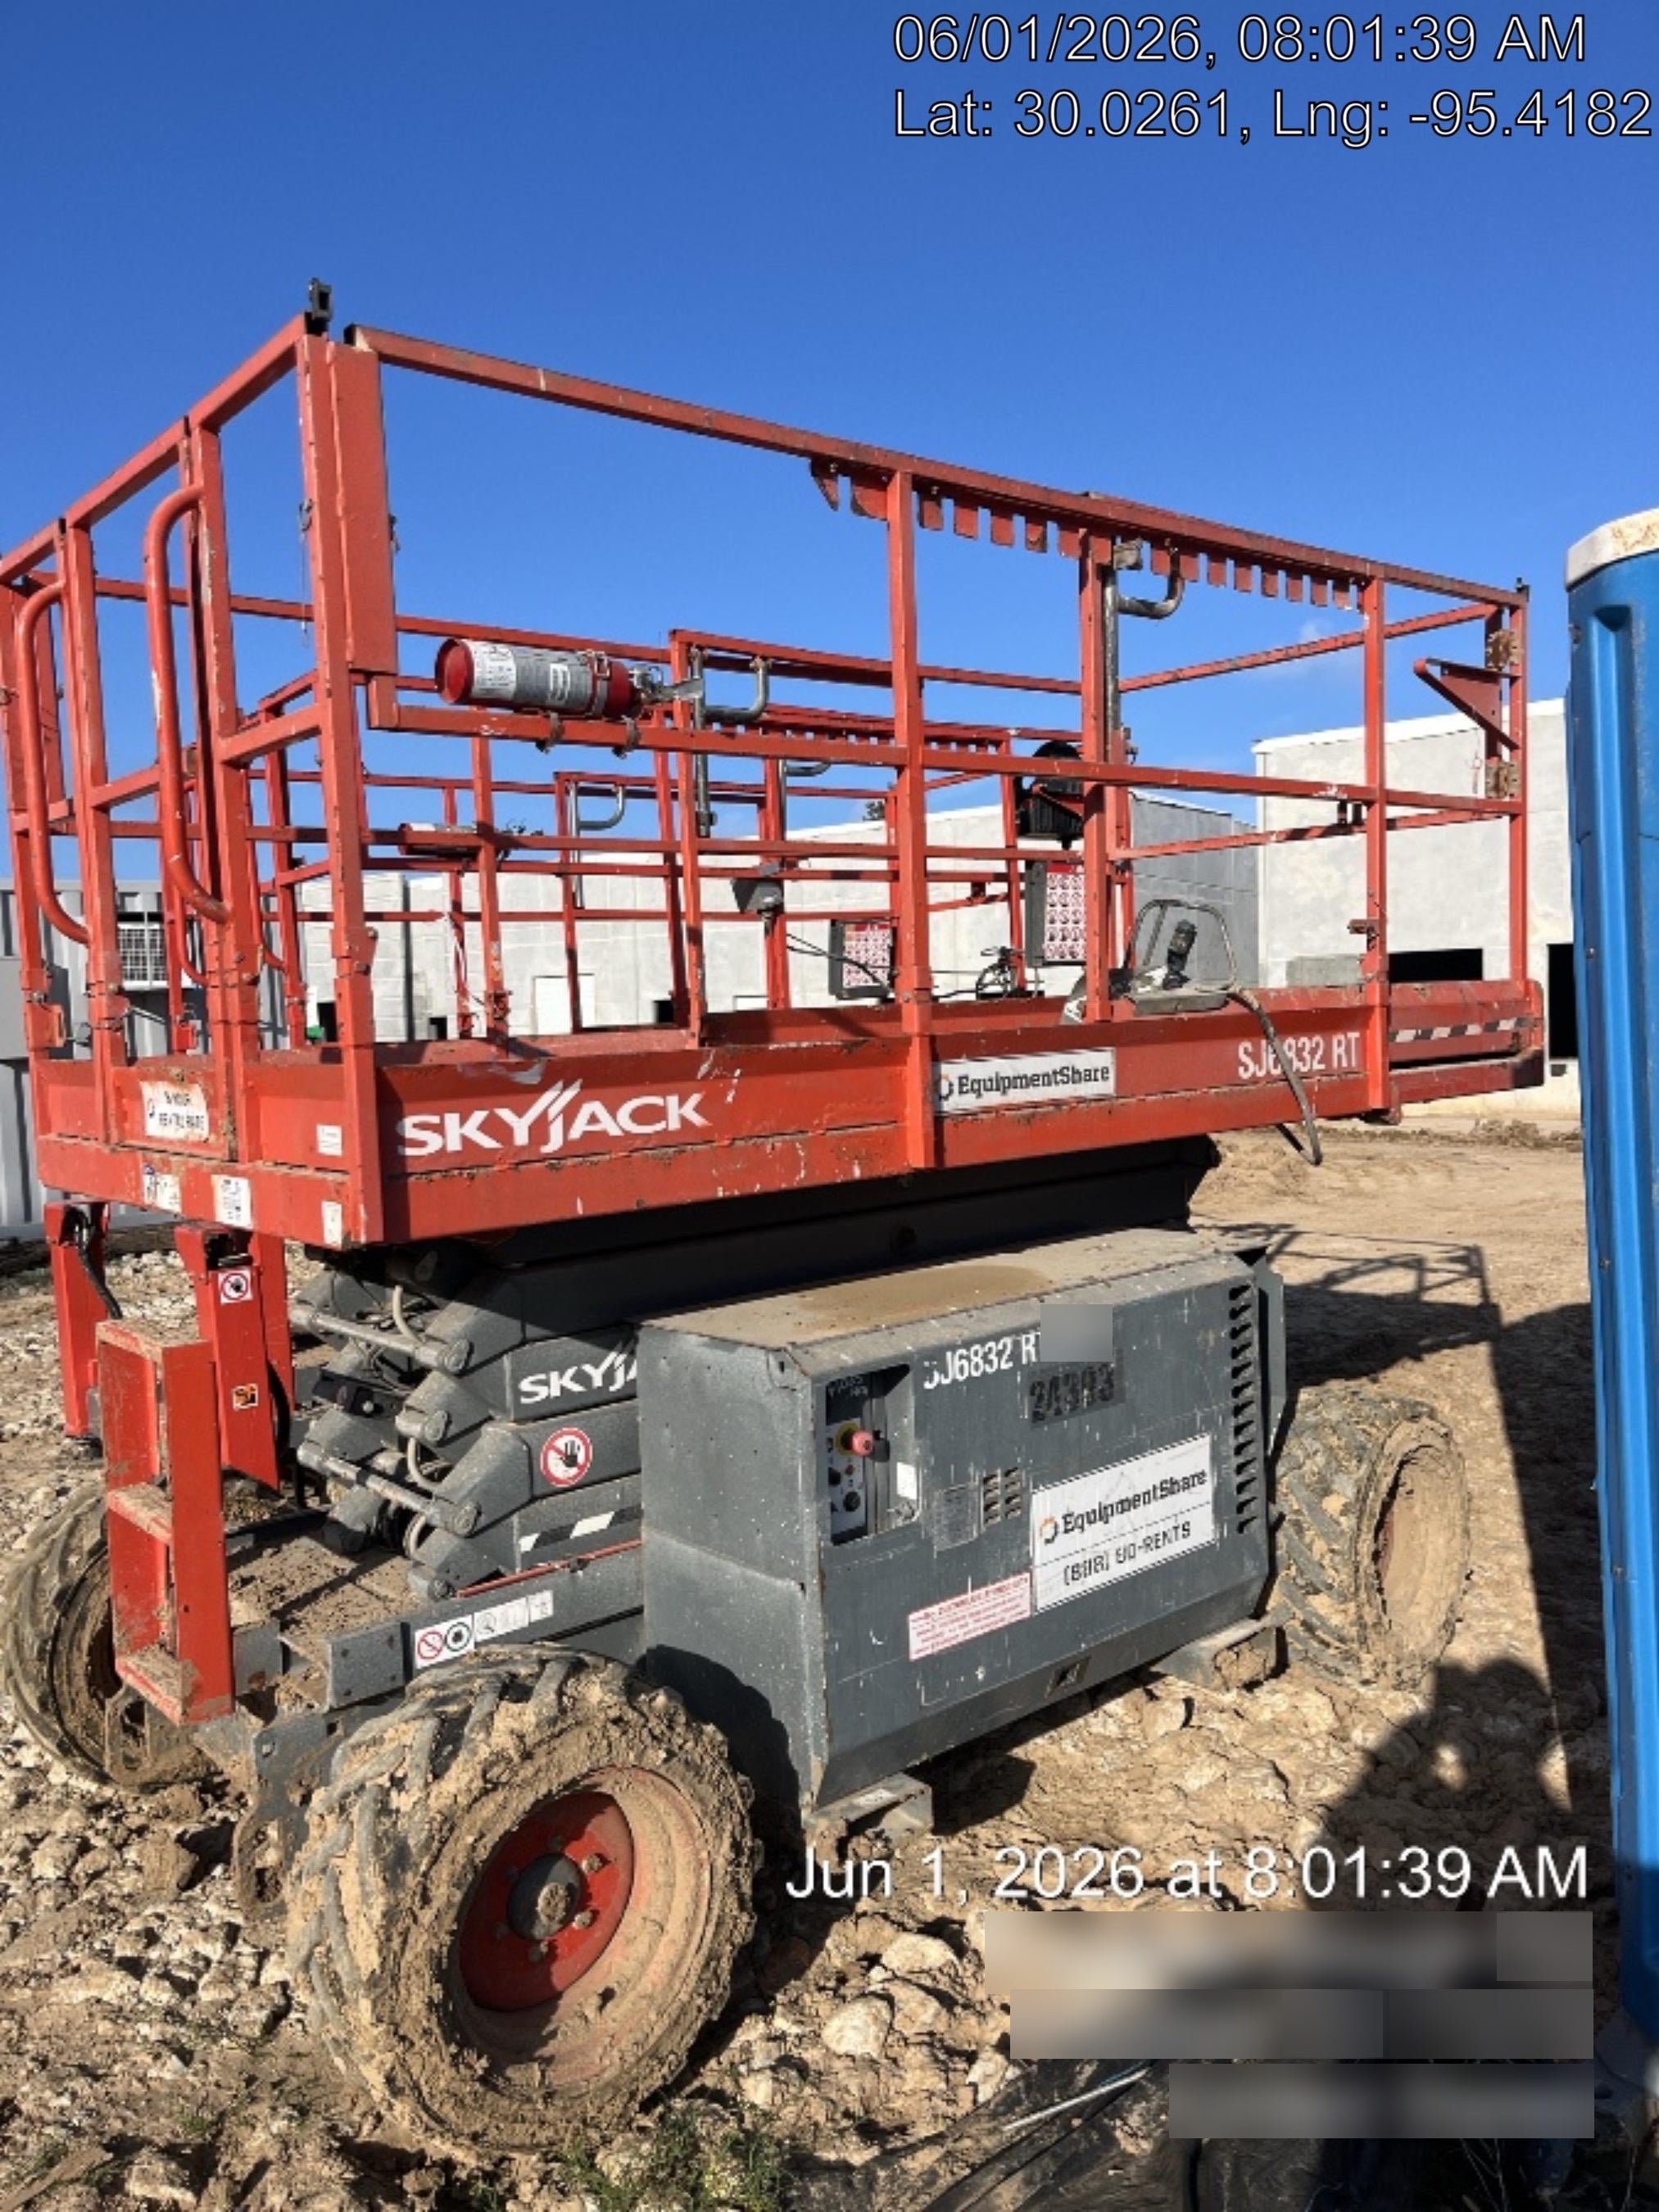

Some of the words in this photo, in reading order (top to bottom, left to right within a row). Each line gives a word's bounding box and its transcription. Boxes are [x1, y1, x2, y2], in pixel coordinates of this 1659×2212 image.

[1332, 1031, 1361, 1069] RT
[957, 1066, 1110, 1099] EquipmentShare
[397, 1078, 714, 1157] SKYJACK
[1062, 1470, 1208, 1534] EquipmentShare
